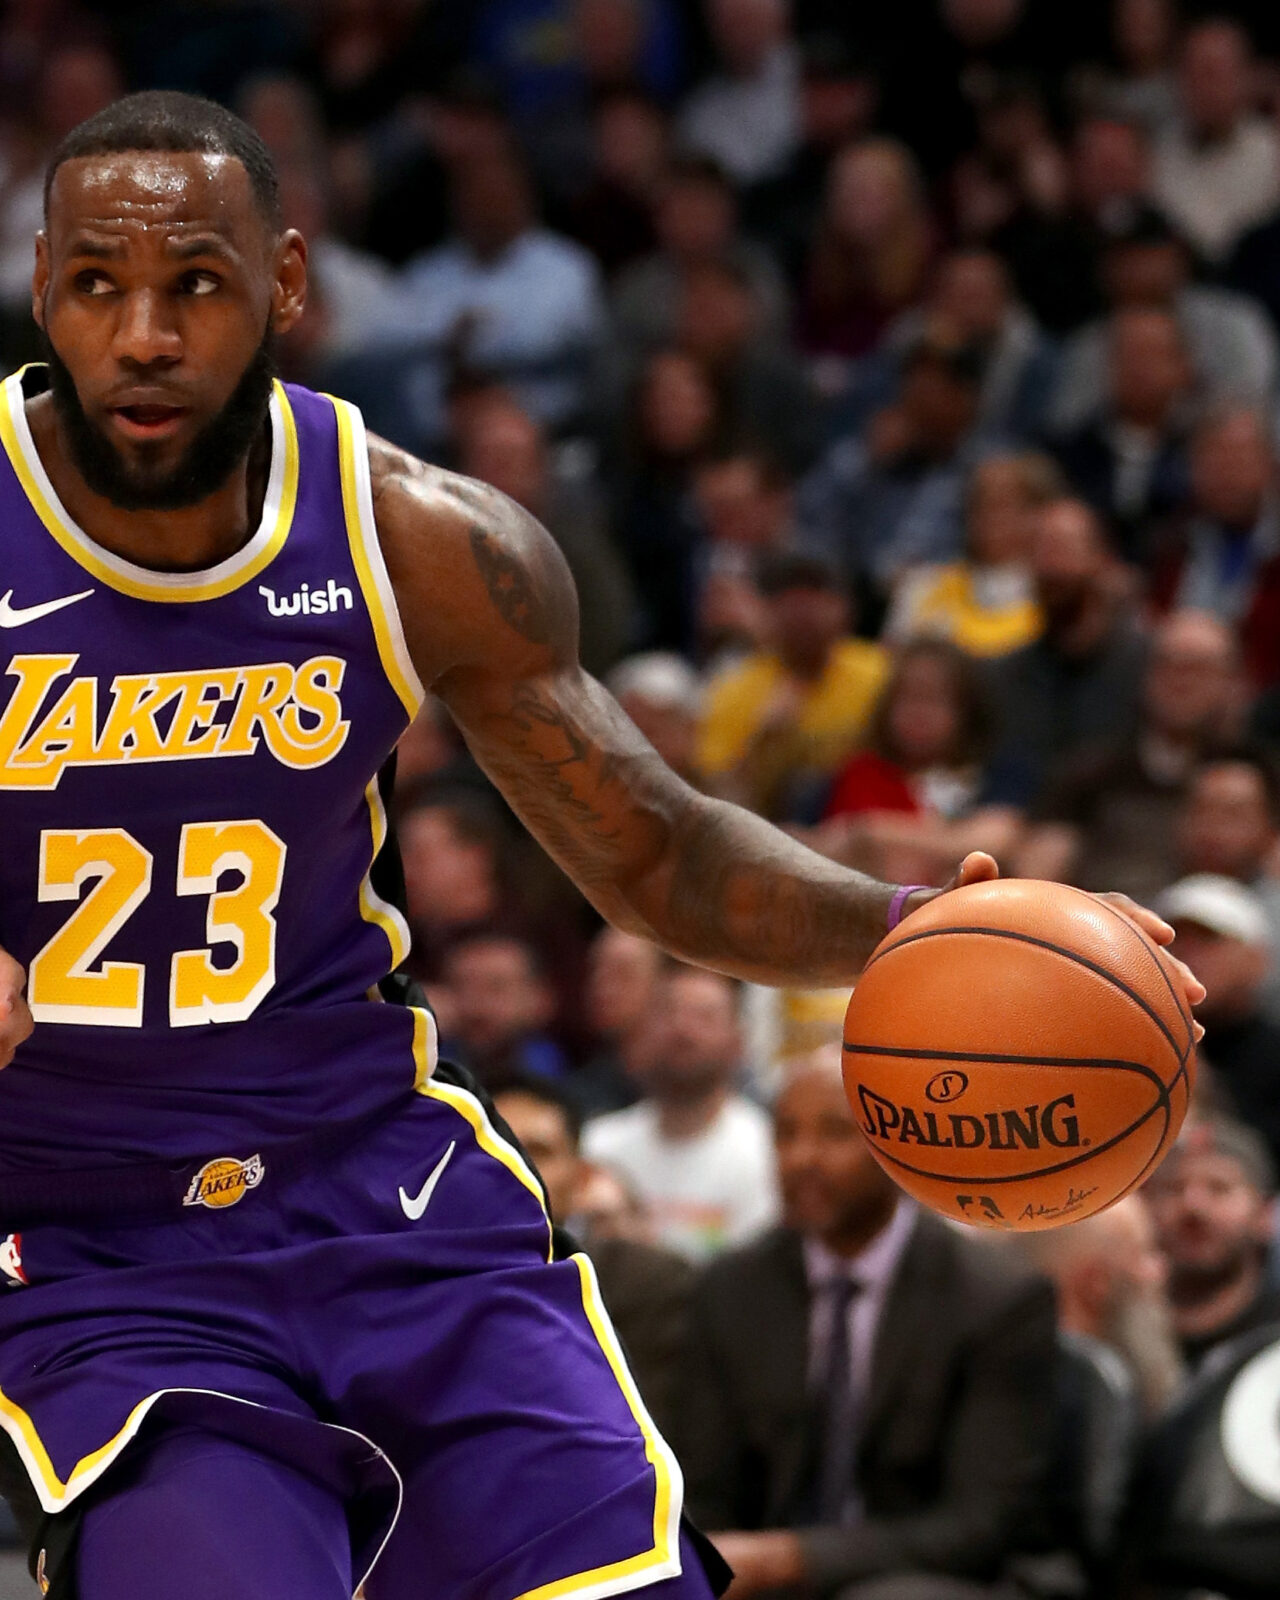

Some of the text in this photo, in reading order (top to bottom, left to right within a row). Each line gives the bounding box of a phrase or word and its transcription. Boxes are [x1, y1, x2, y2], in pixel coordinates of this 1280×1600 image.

[258, 579, 353, 617] wish
[27, 818, 288, 1028] 23
[857, 1083, 1081, 1151] SPALDING
[183, 1162, 261, 1204] LAKERS
